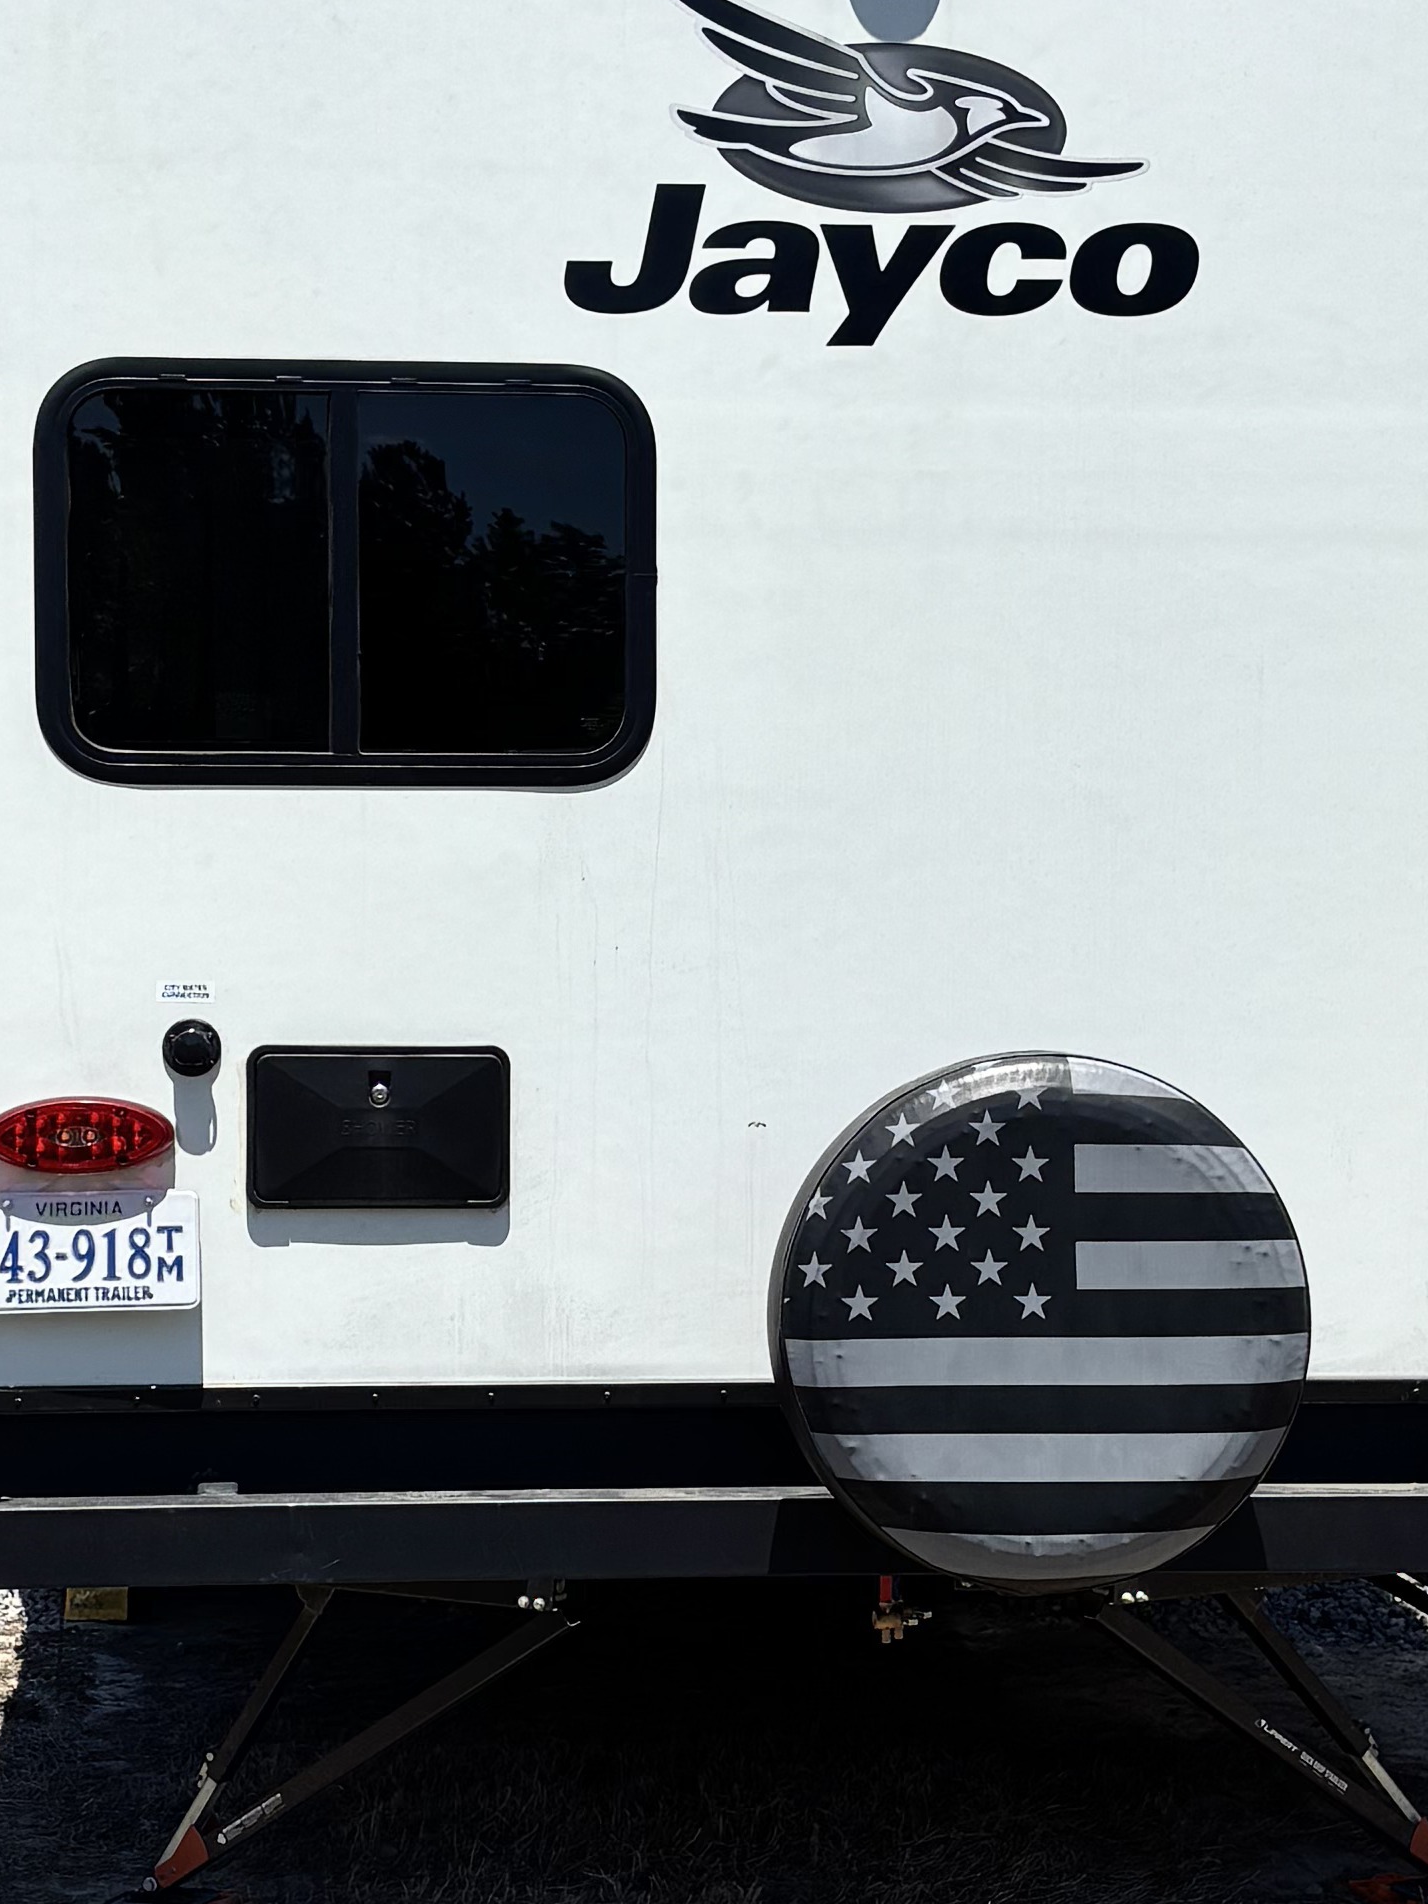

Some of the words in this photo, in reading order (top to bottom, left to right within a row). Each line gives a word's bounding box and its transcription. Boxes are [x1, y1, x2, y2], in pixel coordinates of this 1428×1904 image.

[563, 182, 1200, 347] Jayco
[35, 1200, 124, 1218] VIRGINIA
[5, 1285, 91, 1304] PERMANENT
[94, 1284, 154, 1301] TRAILER
